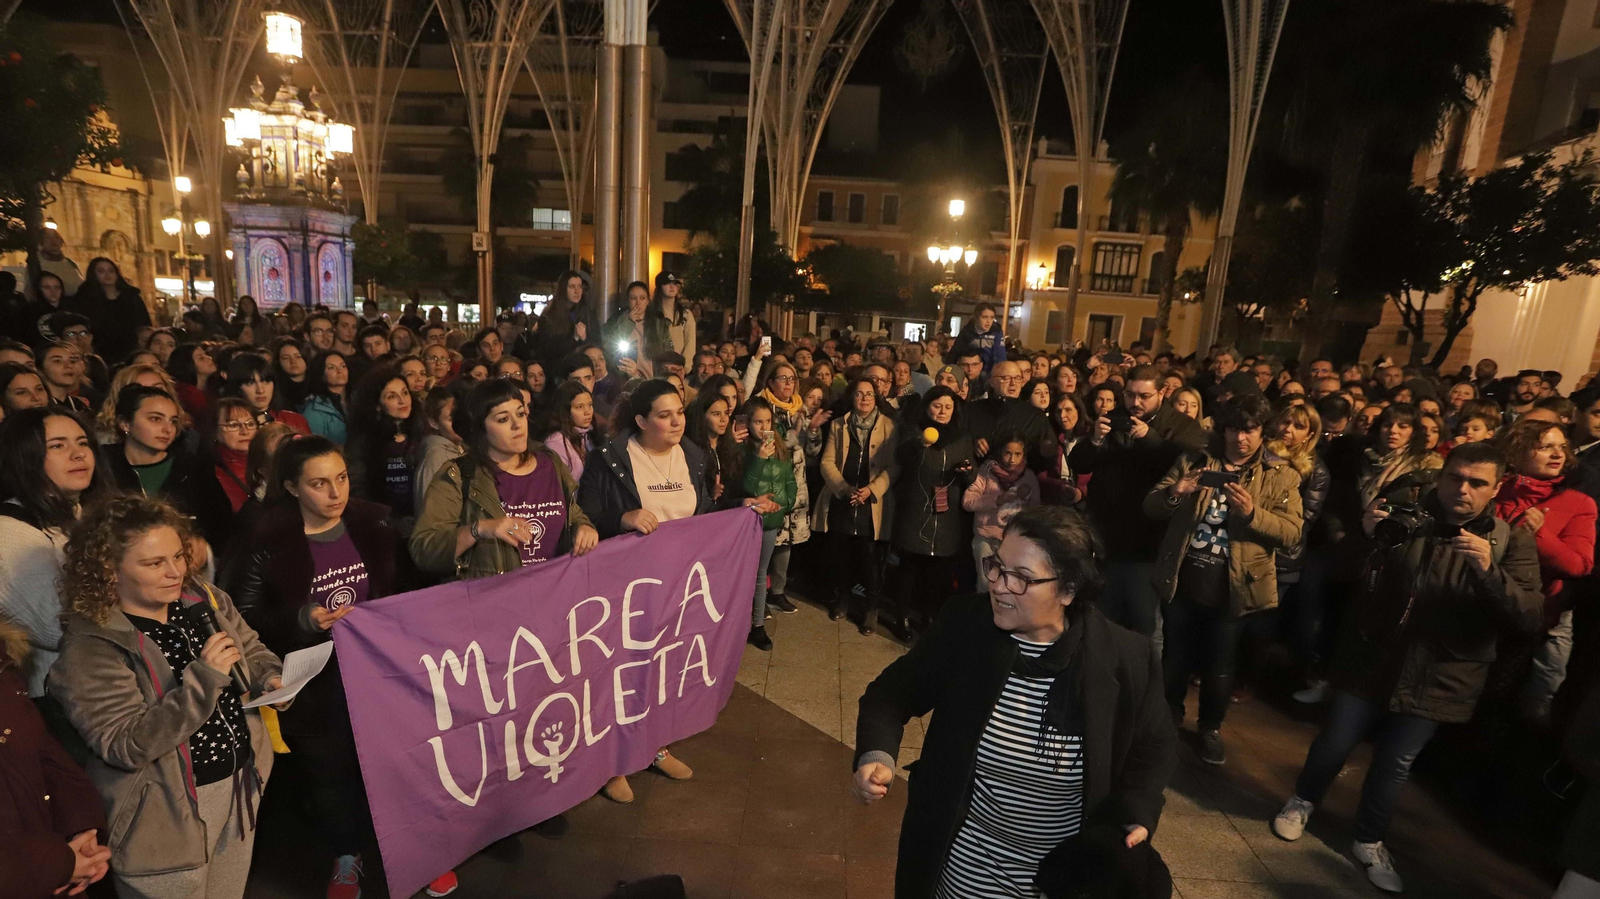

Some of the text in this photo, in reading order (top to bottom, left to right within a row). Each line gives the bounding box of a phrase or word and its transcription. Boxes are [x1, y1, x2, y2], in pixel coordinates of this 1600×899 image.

[313, 562, 365, 583] osotras para
[317, 579, 344, 592] mundo
[345, 575, 355, 584] se
[356, 572, 369, 583] par
[418, 561, 725, 731] MAREA
[427, 634, 717, 807] VIOLETA
